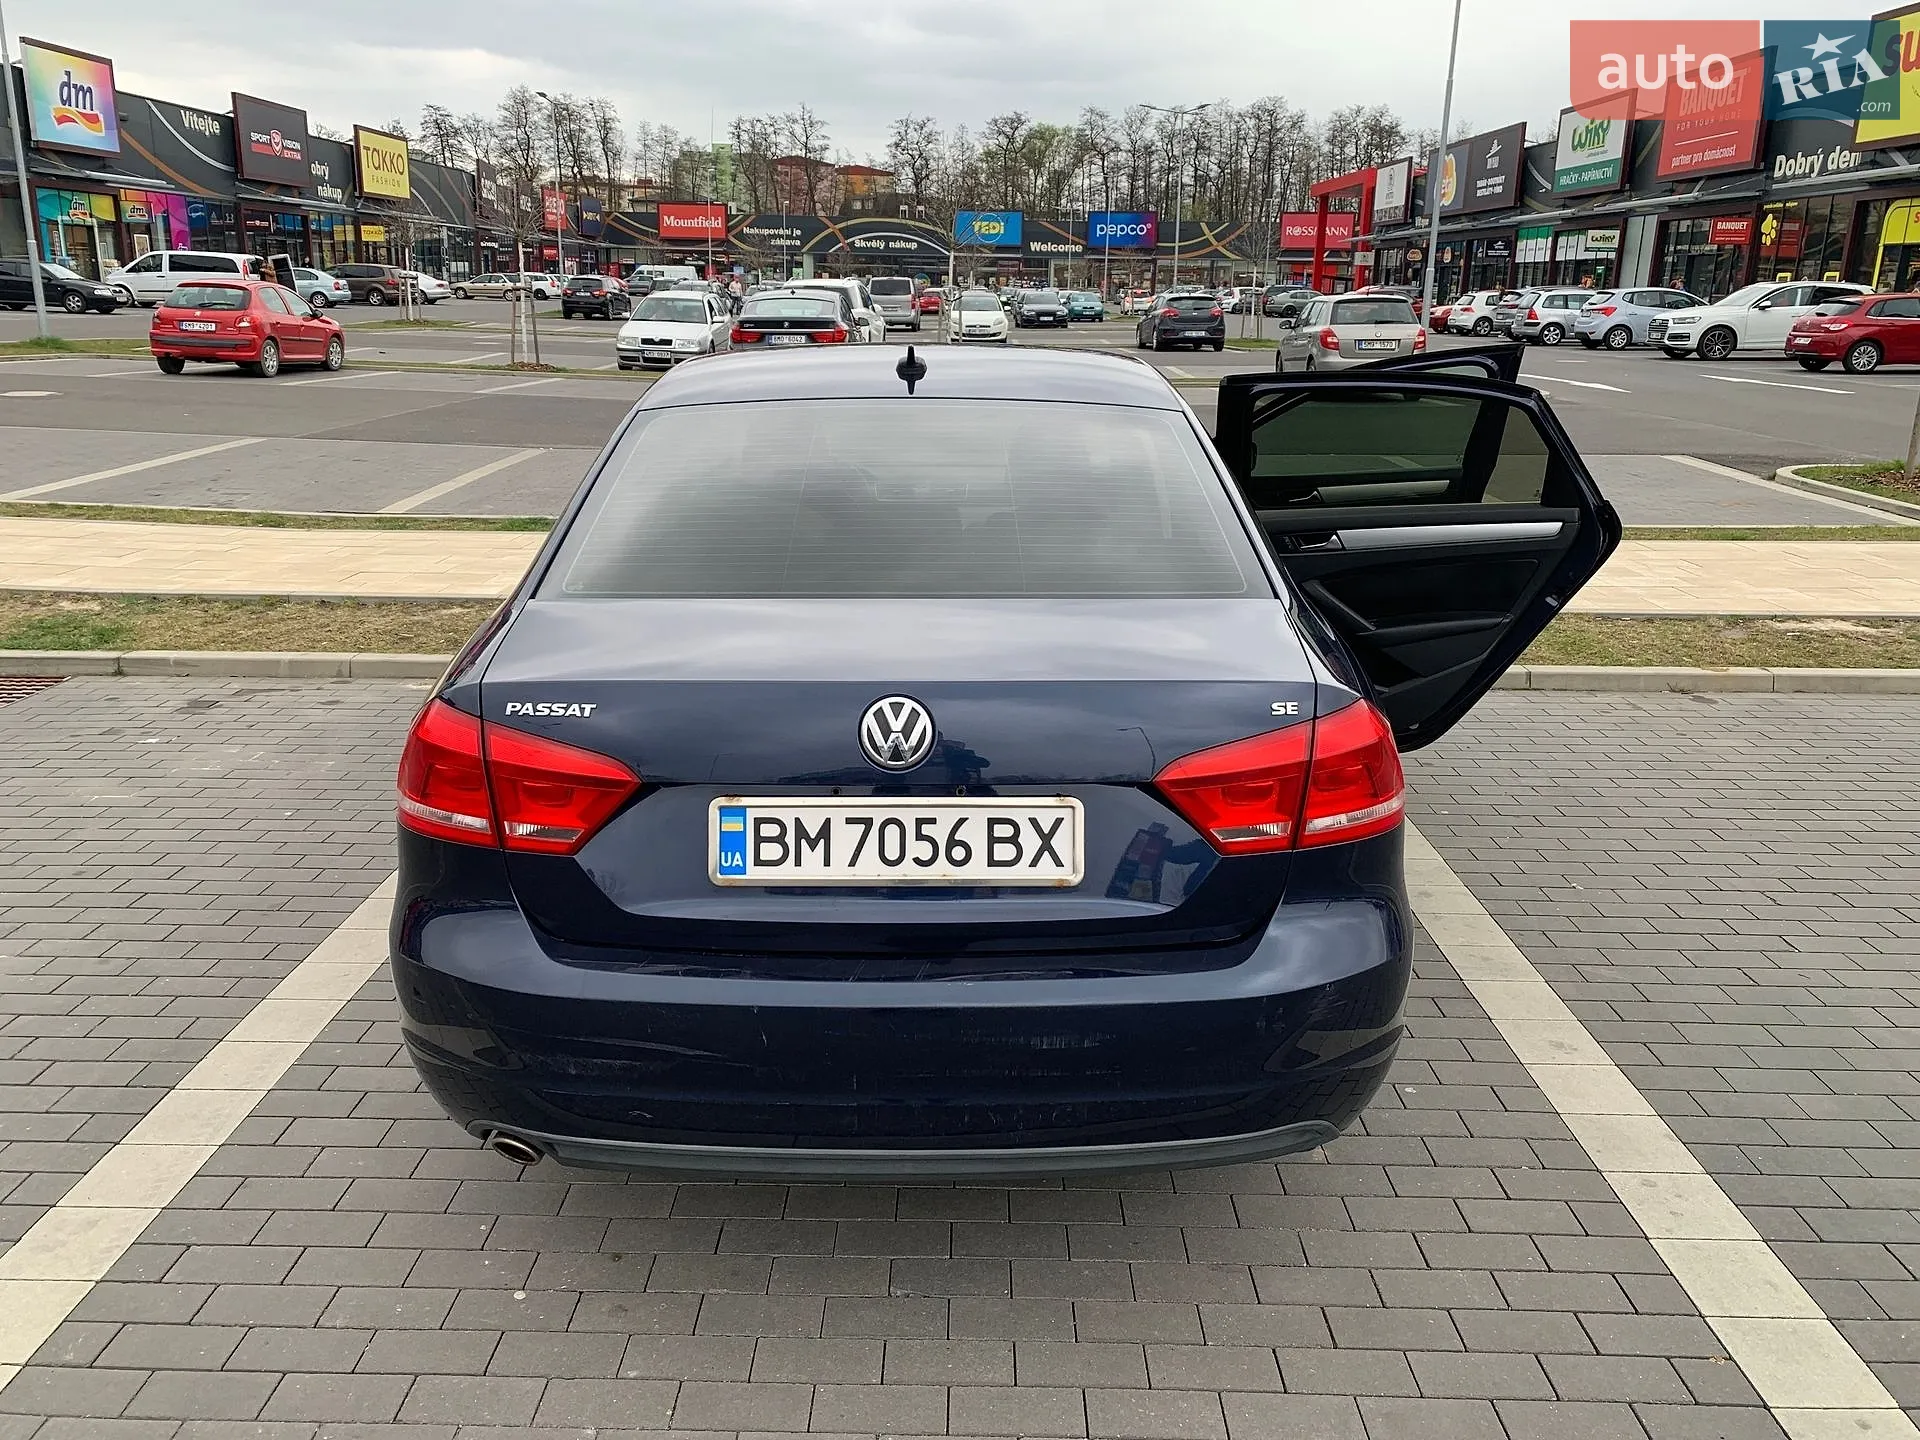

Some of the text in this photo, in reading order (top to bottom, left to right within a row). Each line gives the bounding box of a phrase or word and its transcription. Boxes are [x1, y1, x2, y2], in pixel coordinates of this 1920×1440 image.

[58, 70, 94, 111] dm
[250, 132, 301, 150] SPORT VISION
[284, 150, 301, 161] EXTRA
[1671, 154, 1692, 169] partner
[1692, 152, 1703, 165] pro
[1773, 148, 1824, 178] Dobrý
[372, 175, 401, 188] FASHION
[129, 204, 145, 215] dm
[663, 215, 722, 228] Mountfield
[1717, 221, 1747, 230] BANQUET
[1096, 222, 1147, 237] pepco
[1286, 226, 1348, 237] ROSSANN
[854, 239, 917, 250] Skvělý nákup
[1030, 242, 1083, 253] Welcome
[505, 702, 597, 717] PASSAT
[1271, 701, 1299, 715] SE
[753, 817, 1064, 868] BM 7056 BX
[721, 852, 743, 867] UA
